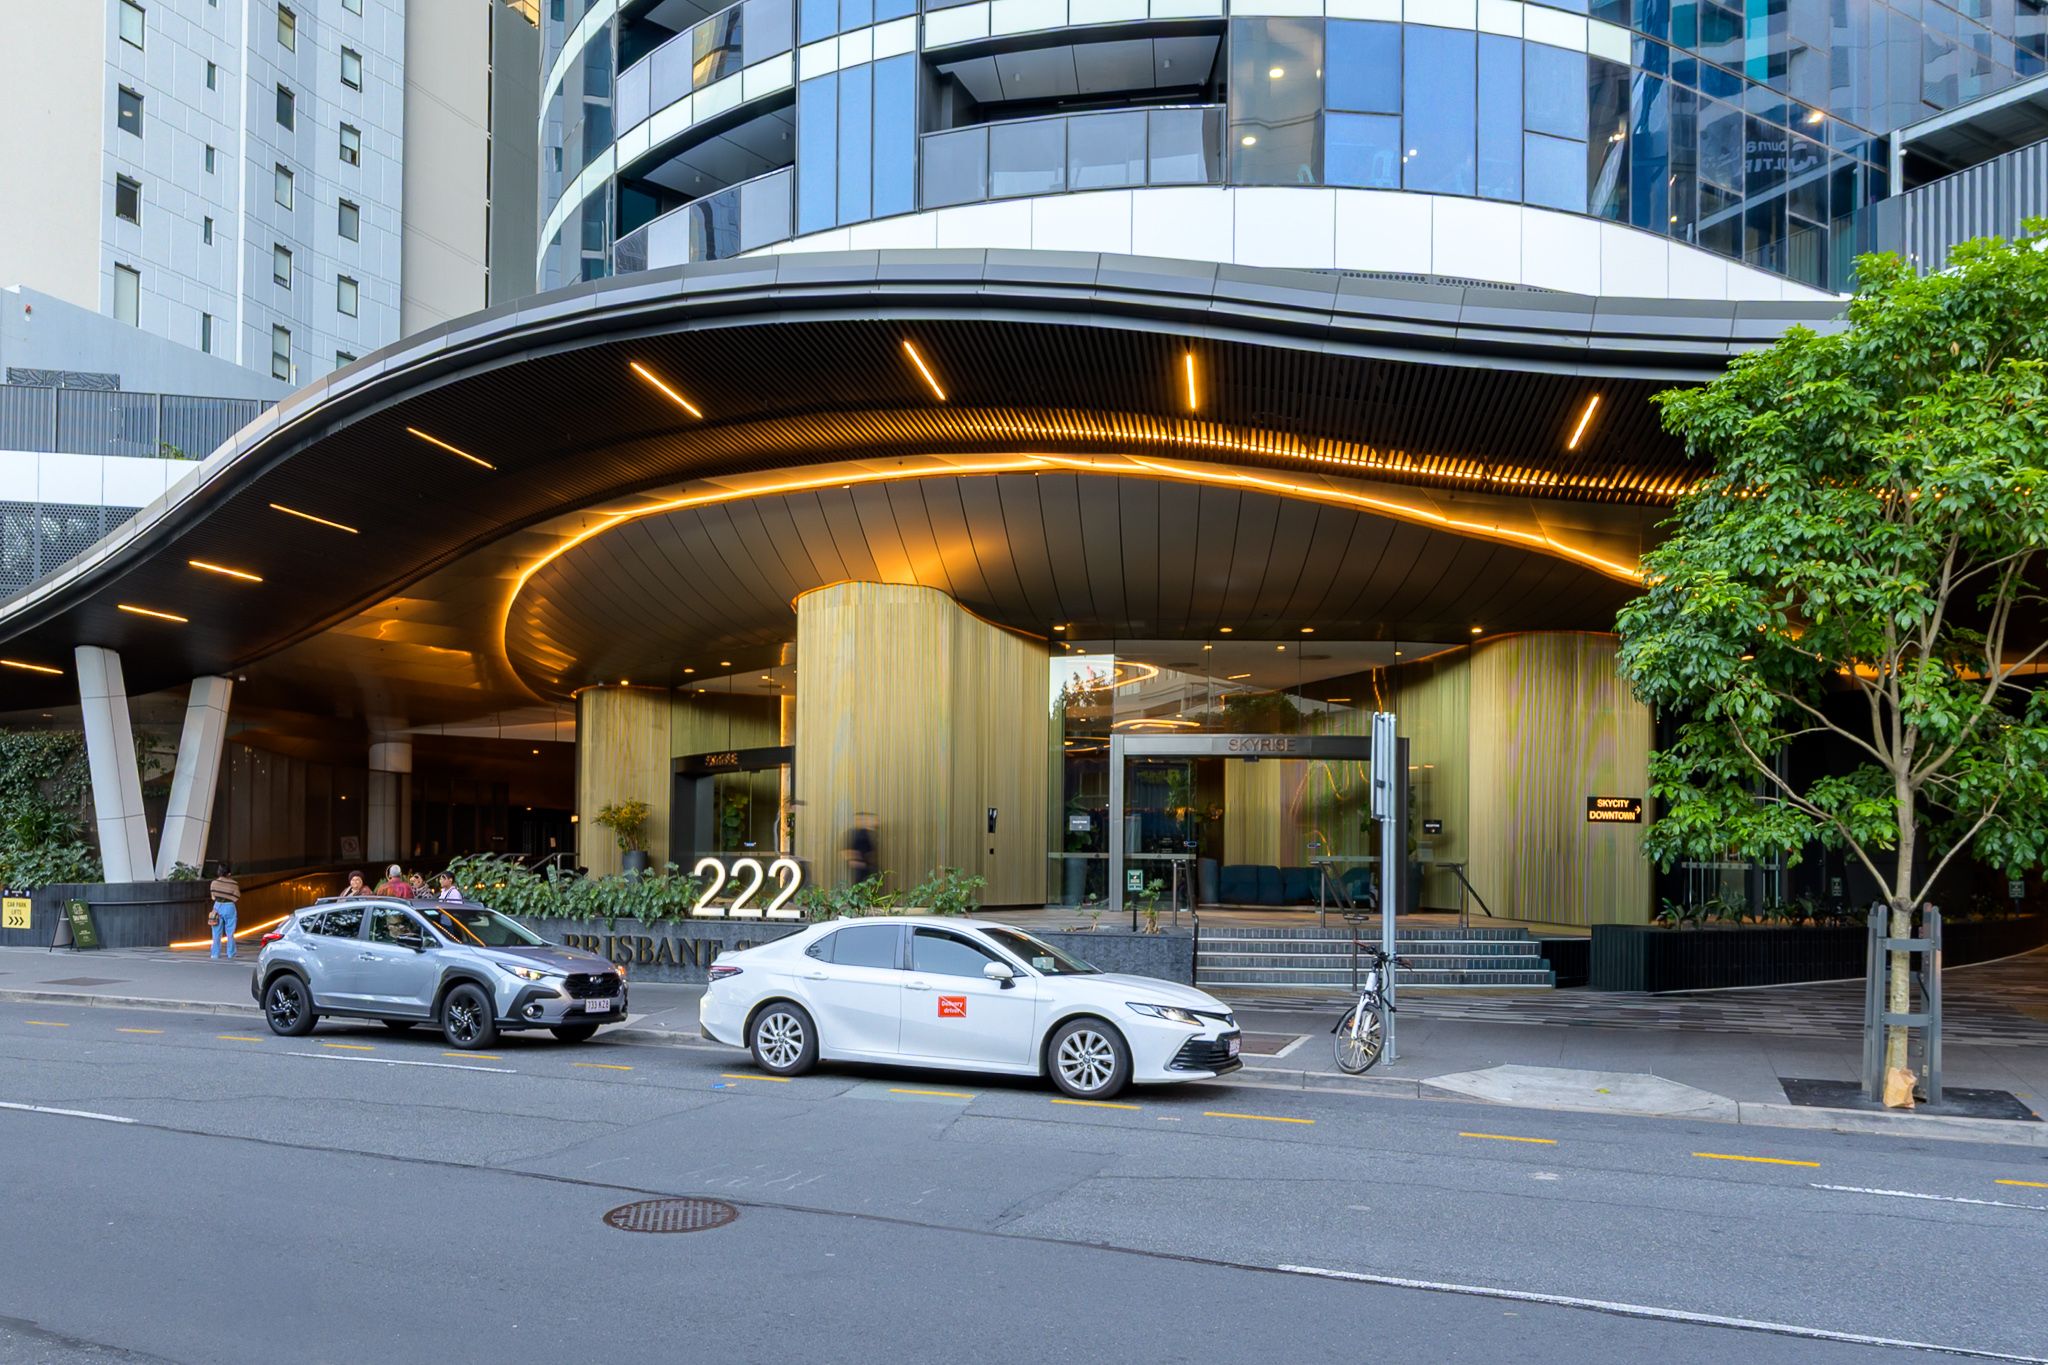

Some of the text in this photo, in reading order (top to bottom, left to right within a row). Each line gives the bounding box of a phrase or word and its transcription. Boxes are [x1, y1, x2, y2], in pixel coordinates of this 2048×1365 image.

[1228, 738, 1297, 752] SKYRISE
[1597, 799, 1630, 808] SKYCITY
[1589, 811, 1636, 820] DOWNTOWN
[692, 857, 801, 919] 222
